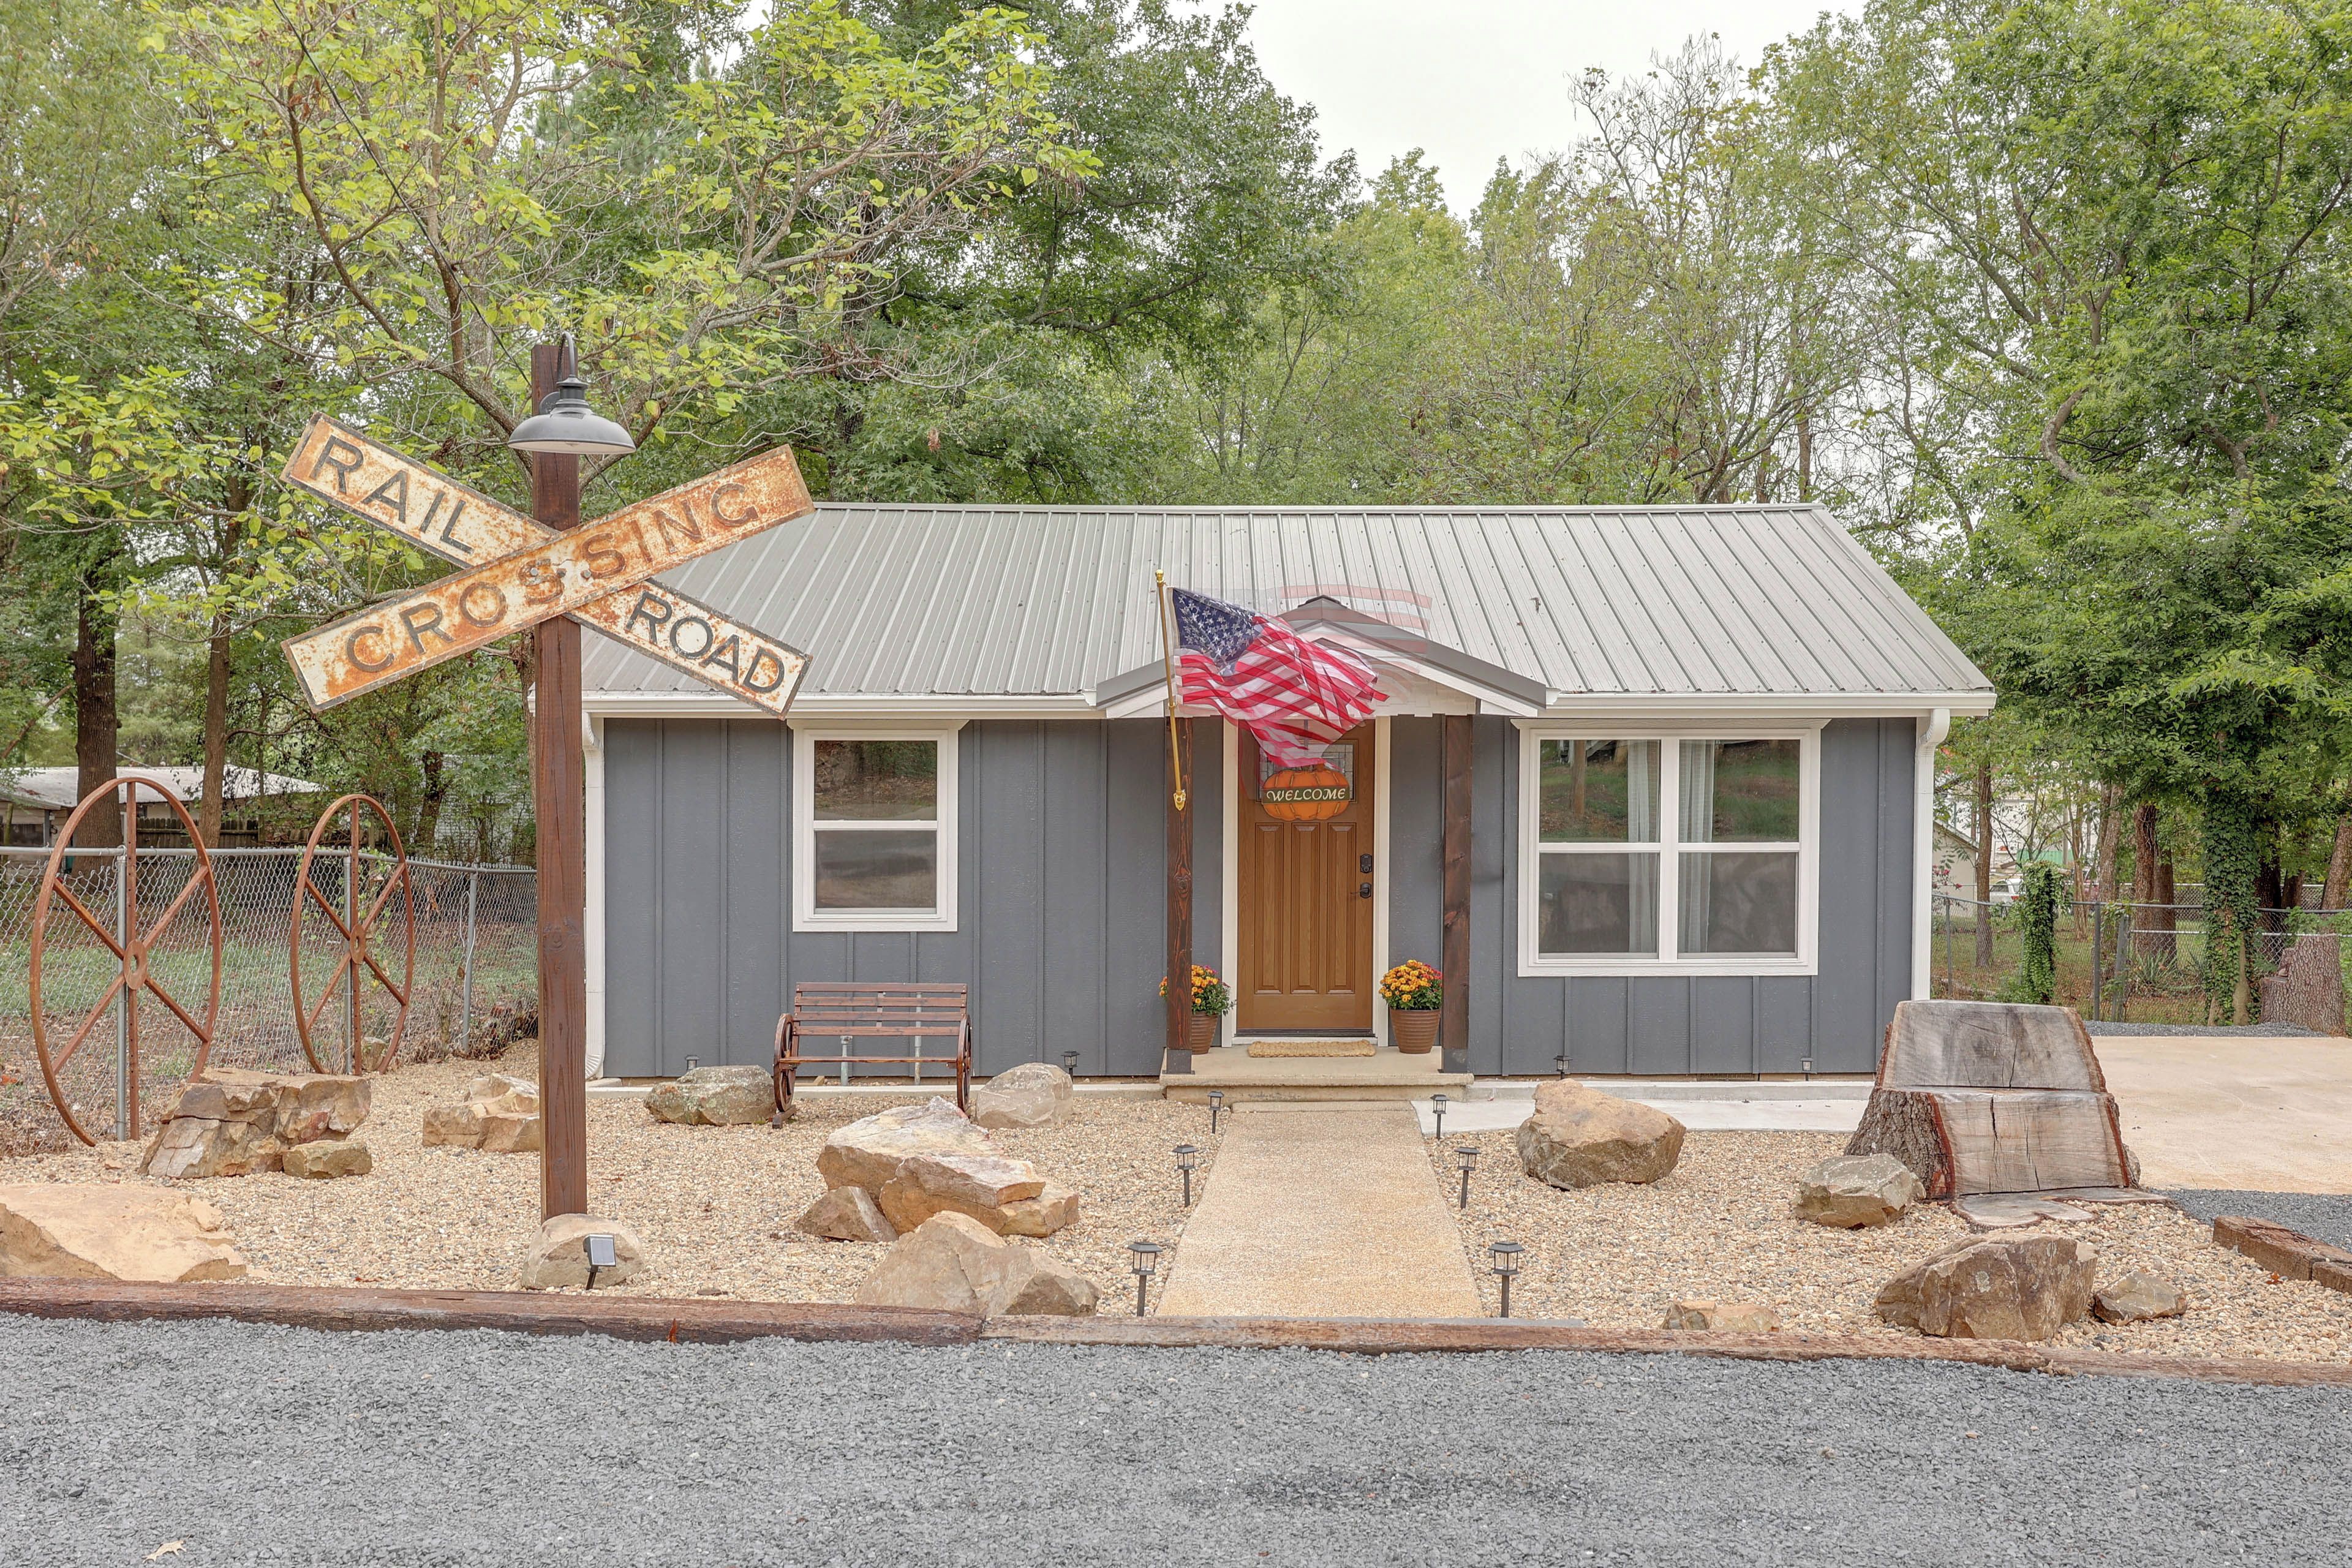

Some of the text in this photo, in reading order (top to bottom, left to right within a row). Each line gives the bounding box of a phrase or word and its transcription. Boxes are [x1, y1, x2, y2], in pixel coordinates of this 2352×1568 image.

[309, 434, 785, 694] RAIL ROAD
[345, 483, 759, 673] CROSSING
[1266, 788, 1346, 802] WELCOME
